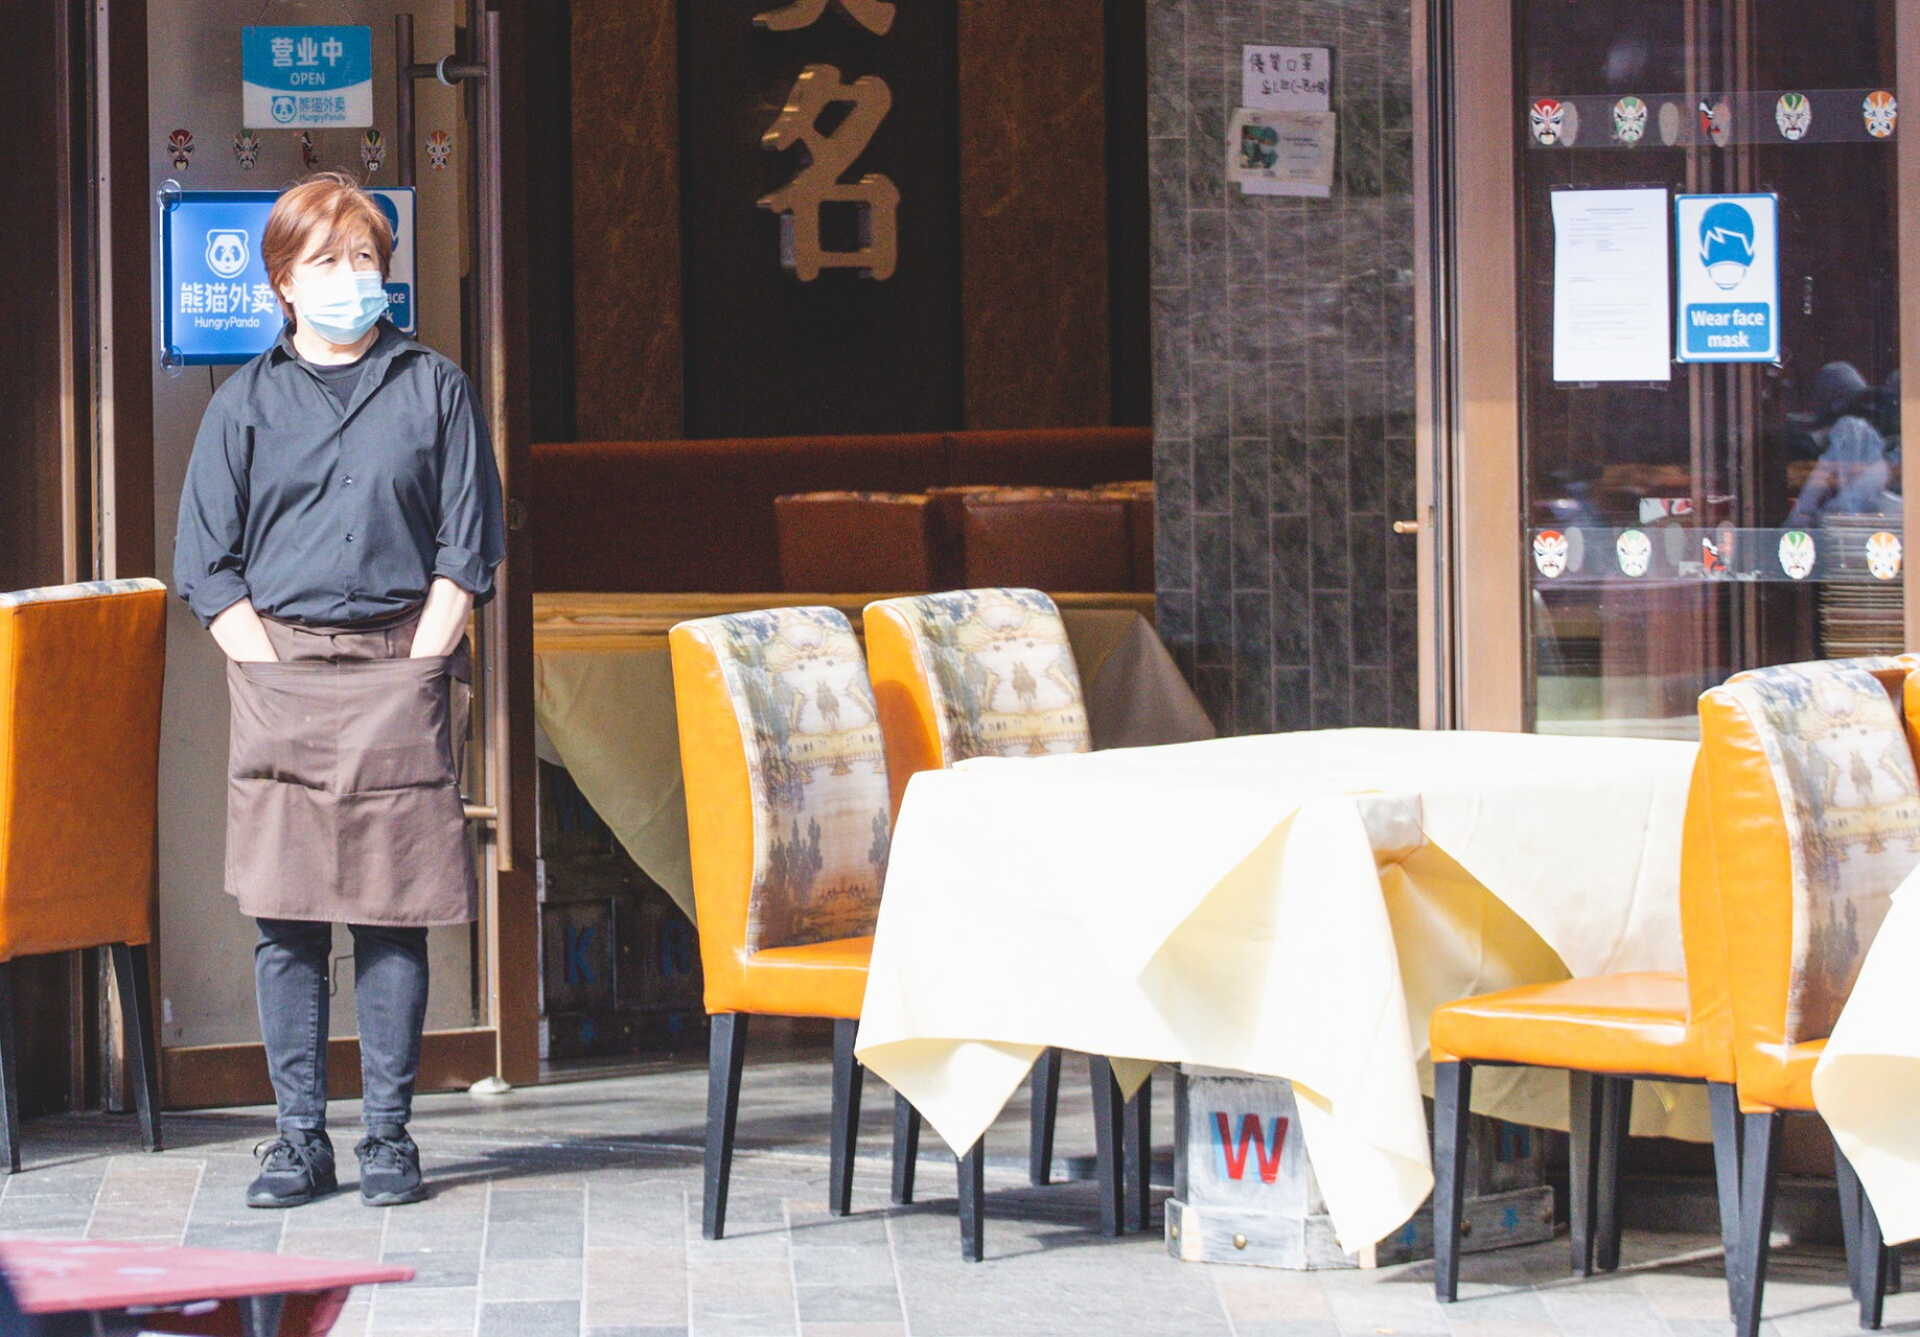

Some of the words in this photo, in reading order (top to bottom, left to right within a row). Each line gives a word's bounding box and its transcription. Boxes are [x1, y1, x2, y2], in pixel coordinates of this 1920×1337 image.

[271, 37, 343, 67] 营业中
[290, 72, 325, 86] OPEN
[180, 282, 274, 313] 熊猫外卖
[194, 316, 260, 330] HungryPanda
[1691, 310, 1730, 327] Wear
[1732, 309, 1765, 327] face
[1707, 331, 1749, 347] mask
[1209, 1111, 1289, 1184] W
